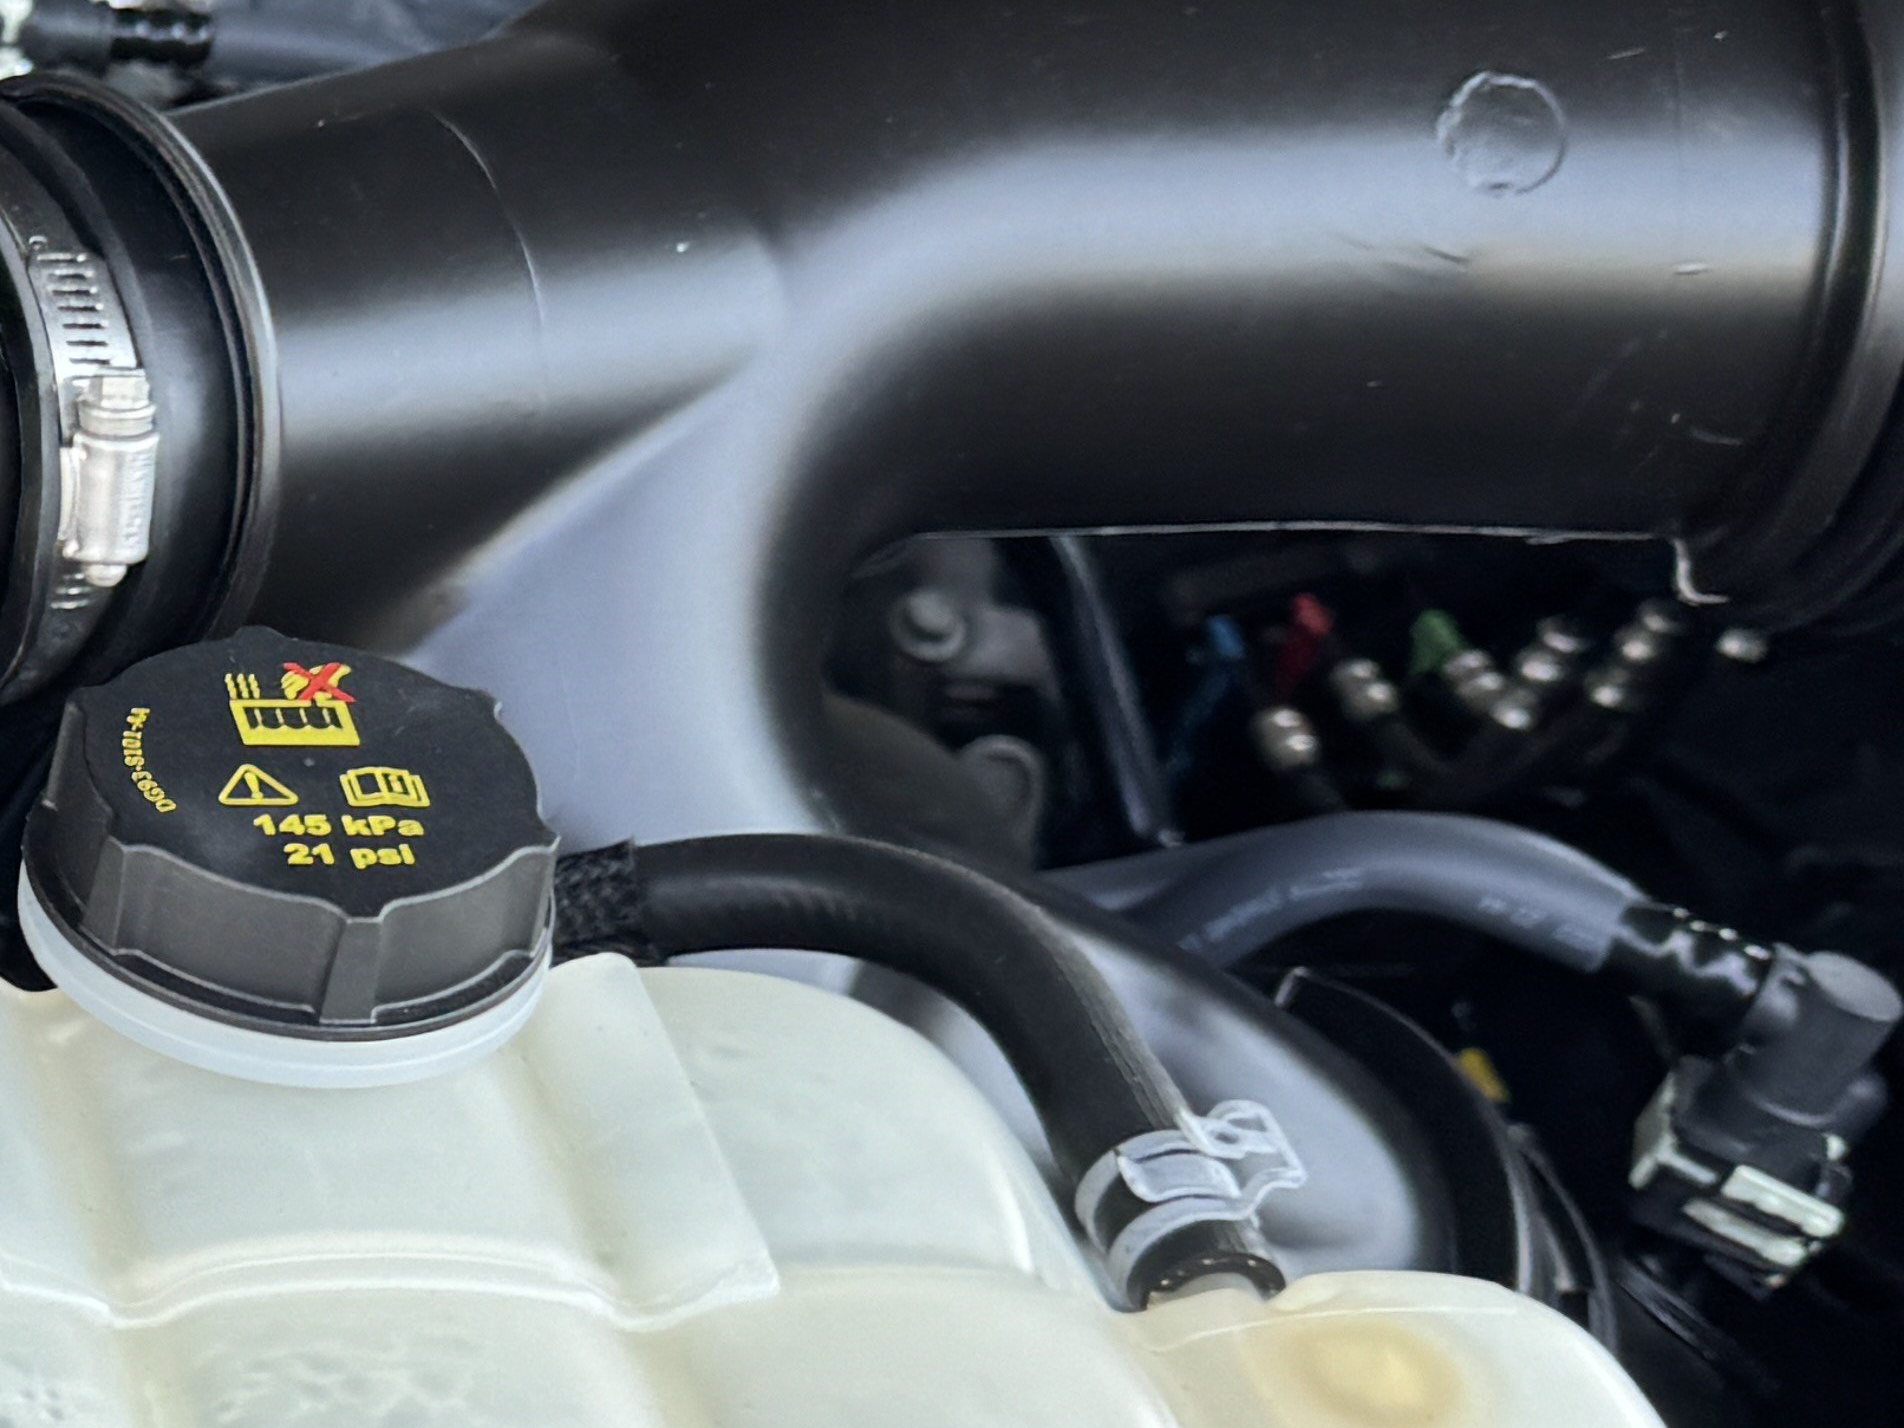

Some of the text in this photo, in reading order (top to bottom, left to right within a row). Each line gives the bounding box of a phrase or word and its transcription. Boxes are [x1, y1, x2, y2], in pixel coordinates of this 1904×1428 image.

[253, 813, 424, 836] 145 kPa
[283, 842, 415, 870] 21 psi
